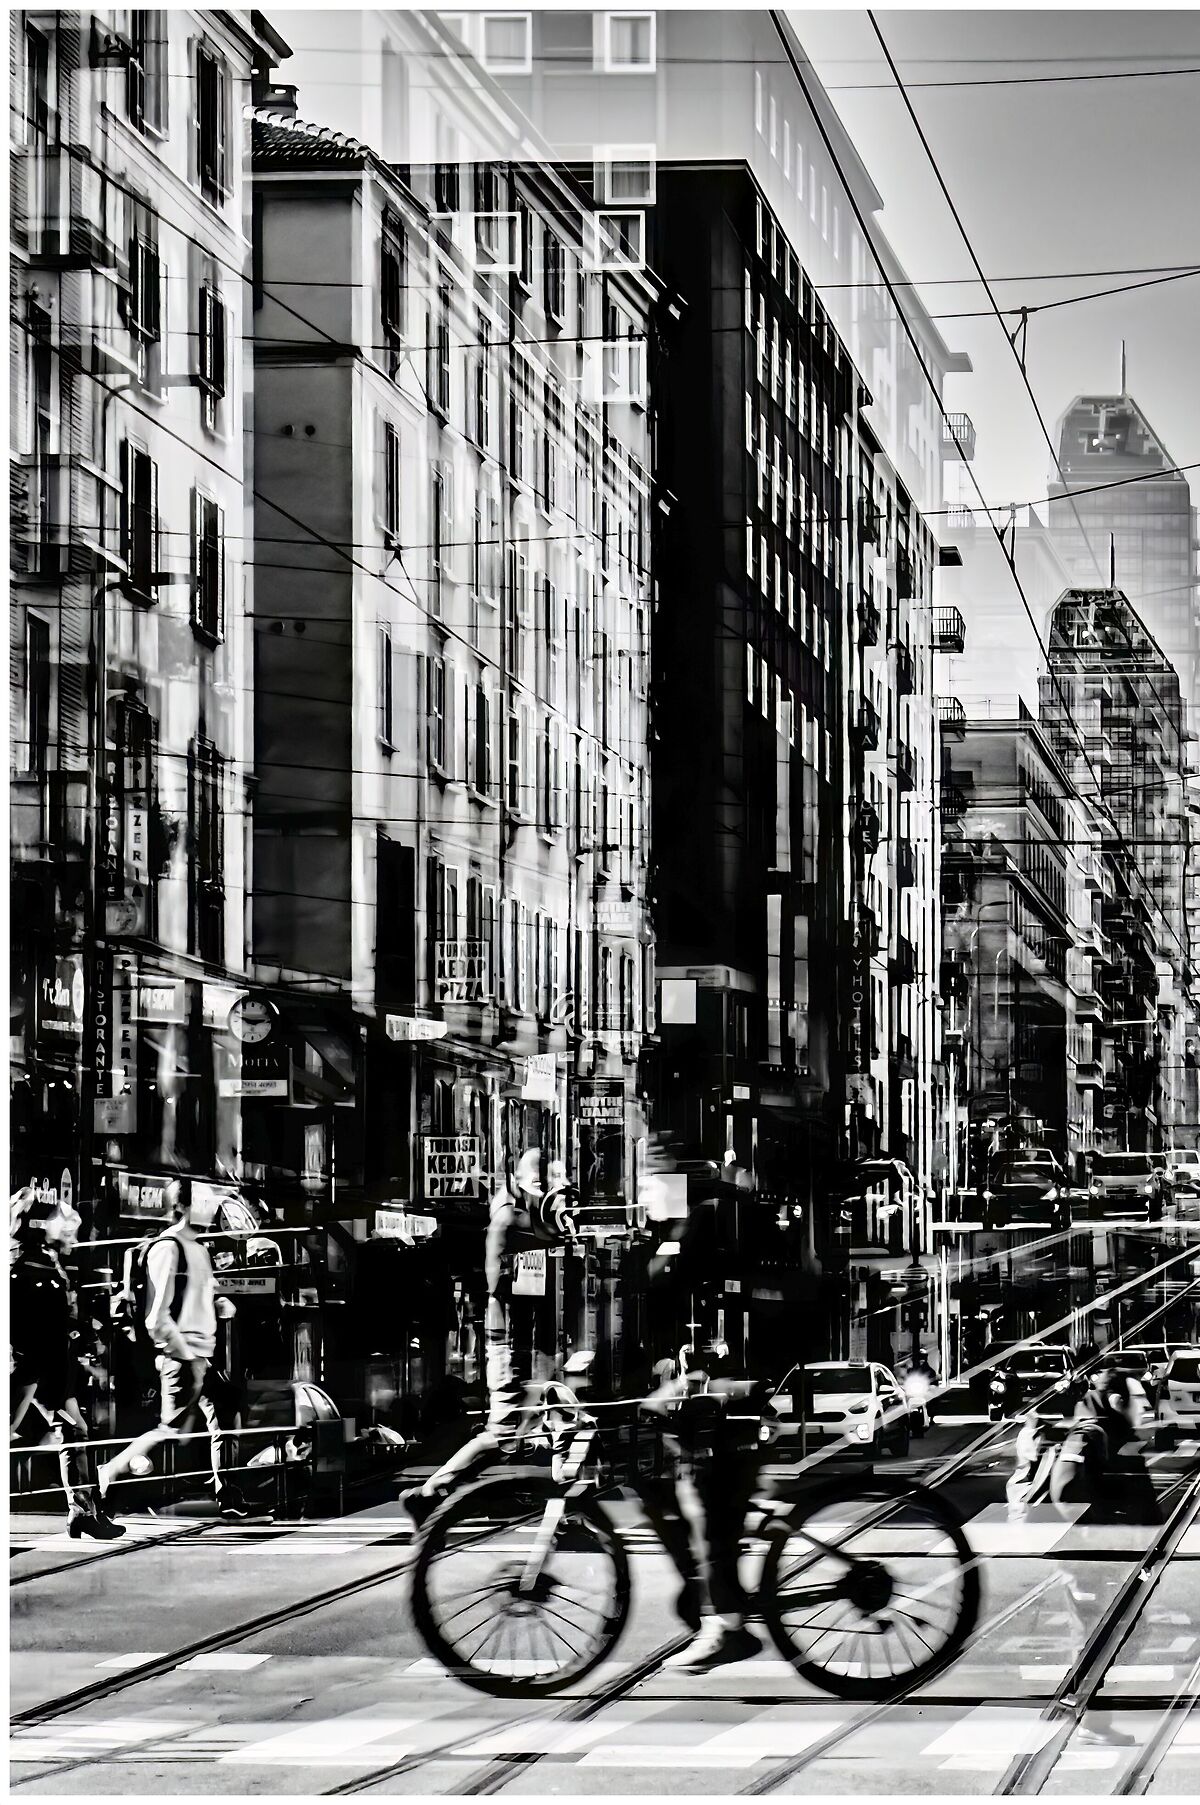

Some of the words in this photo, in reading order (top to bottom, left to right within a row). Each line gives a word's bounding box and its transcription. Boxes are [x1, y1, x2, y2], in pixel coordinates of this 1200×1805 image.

[438, 981, 484, 1001] PIZZA
[95, 960, 107, 1095] RISTORANTE
[582, 1107, 622, 1118] DAME
[429, 1177, 475, 1197] PIZZA
